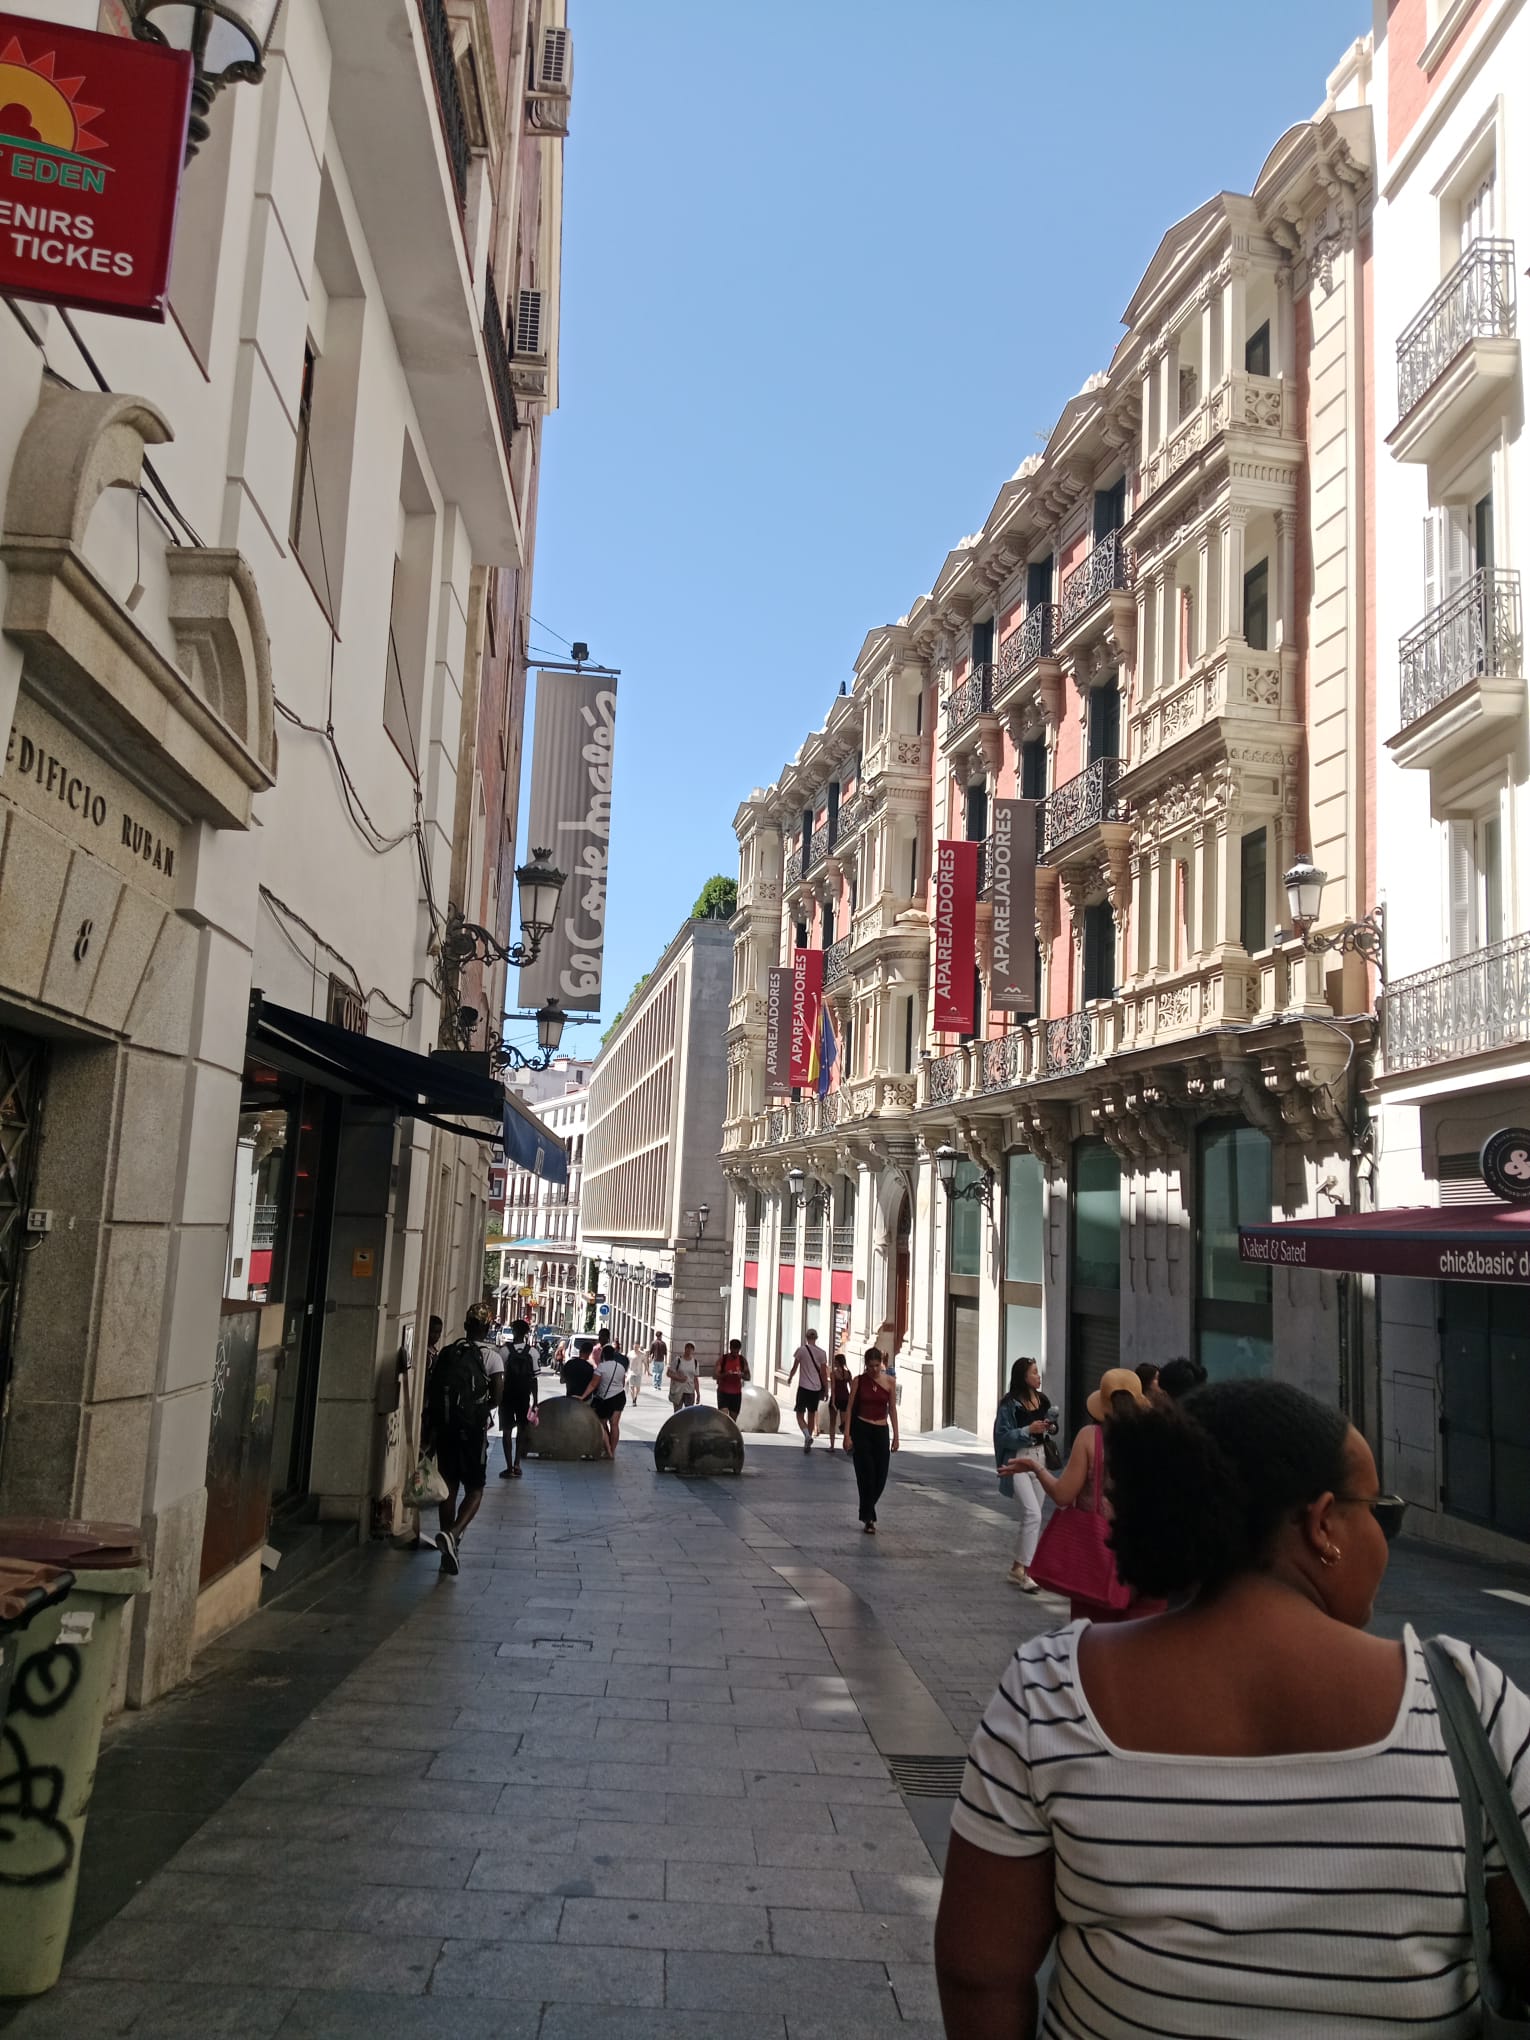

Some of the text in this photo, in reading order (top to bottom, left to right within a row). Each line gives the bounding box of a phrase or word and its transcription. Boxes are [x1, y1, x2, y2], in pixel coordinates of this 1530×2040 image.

[11, 153, 105, 194] EDEN
[10, 232, 134, 277] TICKES
[121, 814, 174, 877] RUBAN
[993, 807, 1013, 976] APAREJADORES
[73, 918, 93, 962] 8
[936, 848, 955, 1000] APAREJADORES
[766, 972, 781, 1076] APAREJADORES
[1242, 1237, 1307, 1263] Naked & Sated
[1519, 1251, 1530, 1276] d
